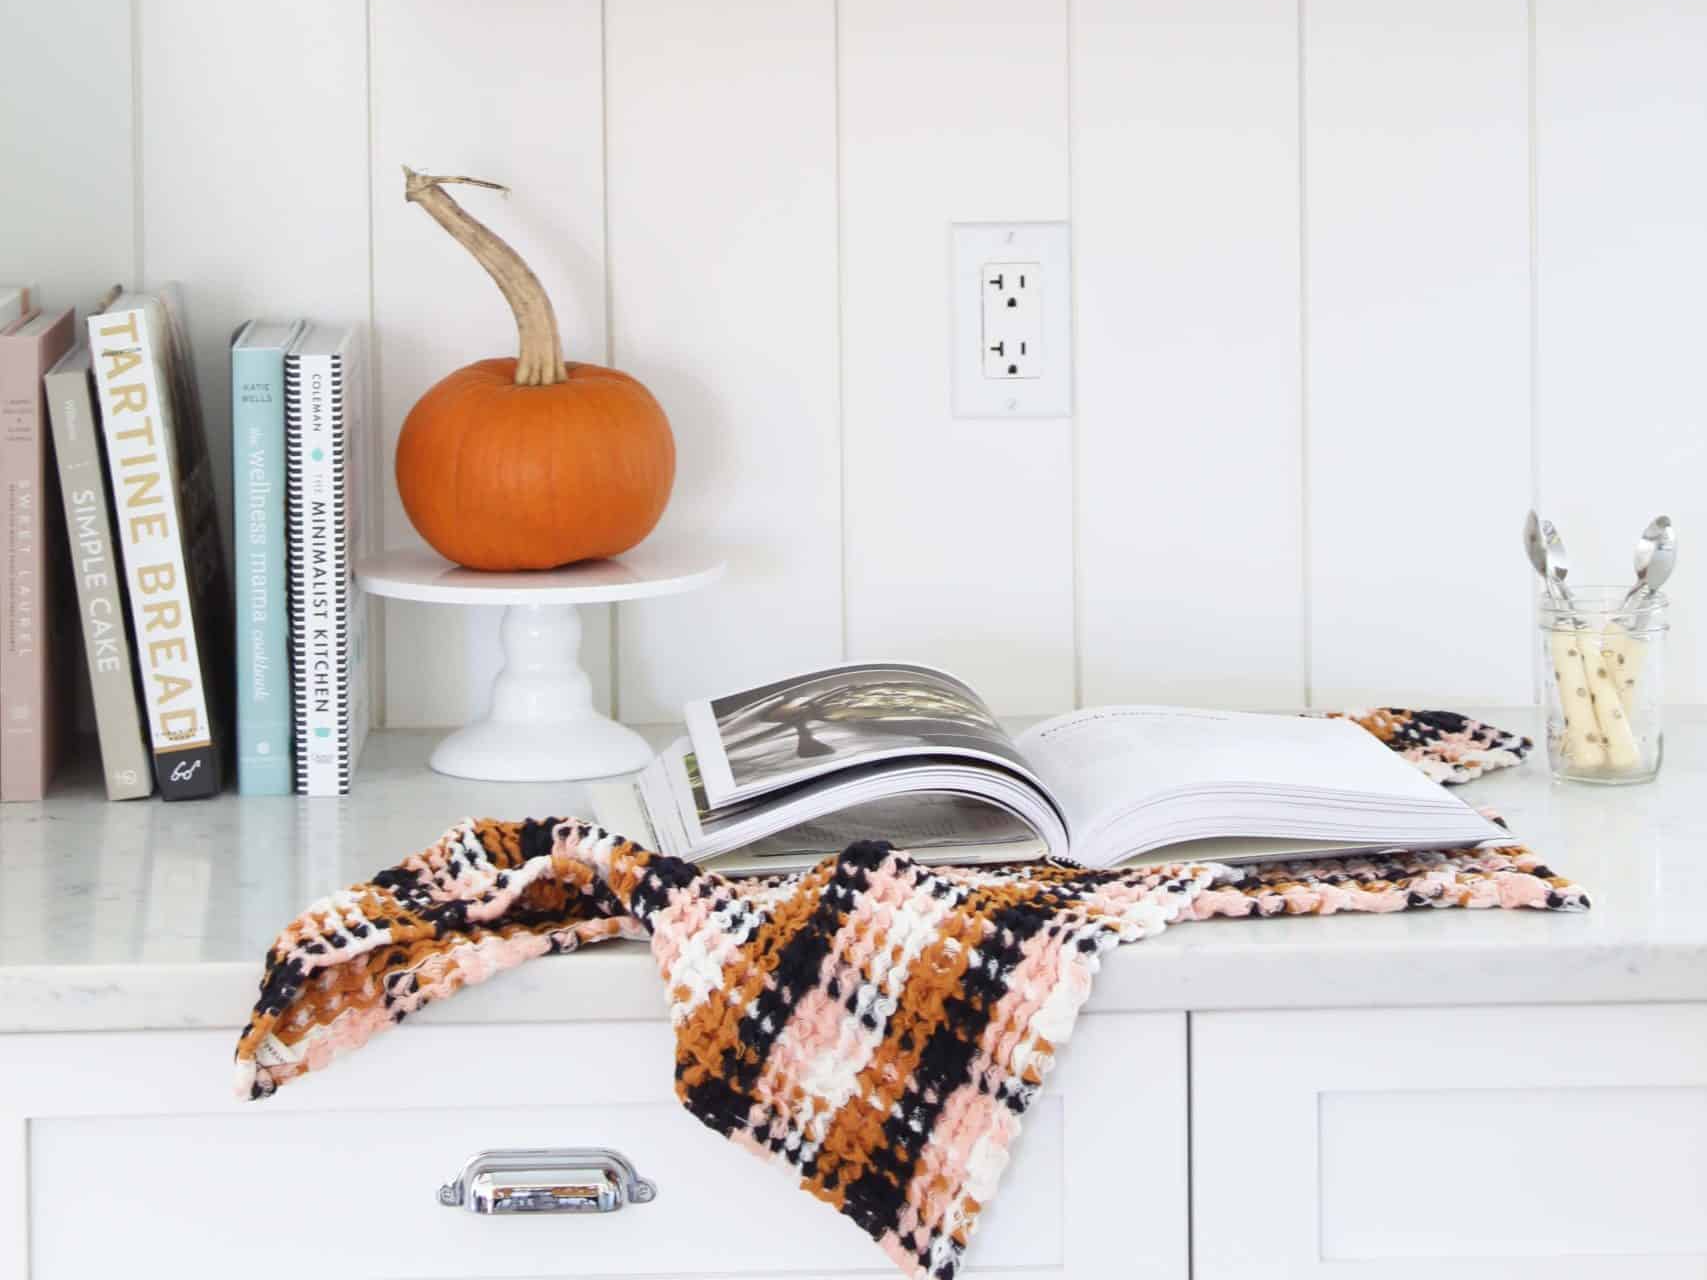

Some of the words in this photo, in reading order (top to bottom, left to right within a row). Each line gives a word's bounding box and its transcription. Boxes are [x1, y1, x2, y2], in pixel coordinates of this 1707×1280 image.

[311, 373, 322, 432] COLEMAN
[72, 489, 108, 590] SIMPLE
[98, 312, 169, 545] TARTINE
[136, 561, 200, 740] BREAD
[249, 449, 272, 545] wellness
[250, 550, 268, 623] mama
[311, 501, 330, 618] MINIMALIST
[89, 597, 121, 674] CAKE
[313, 628, 330, 713] KITCHEN
